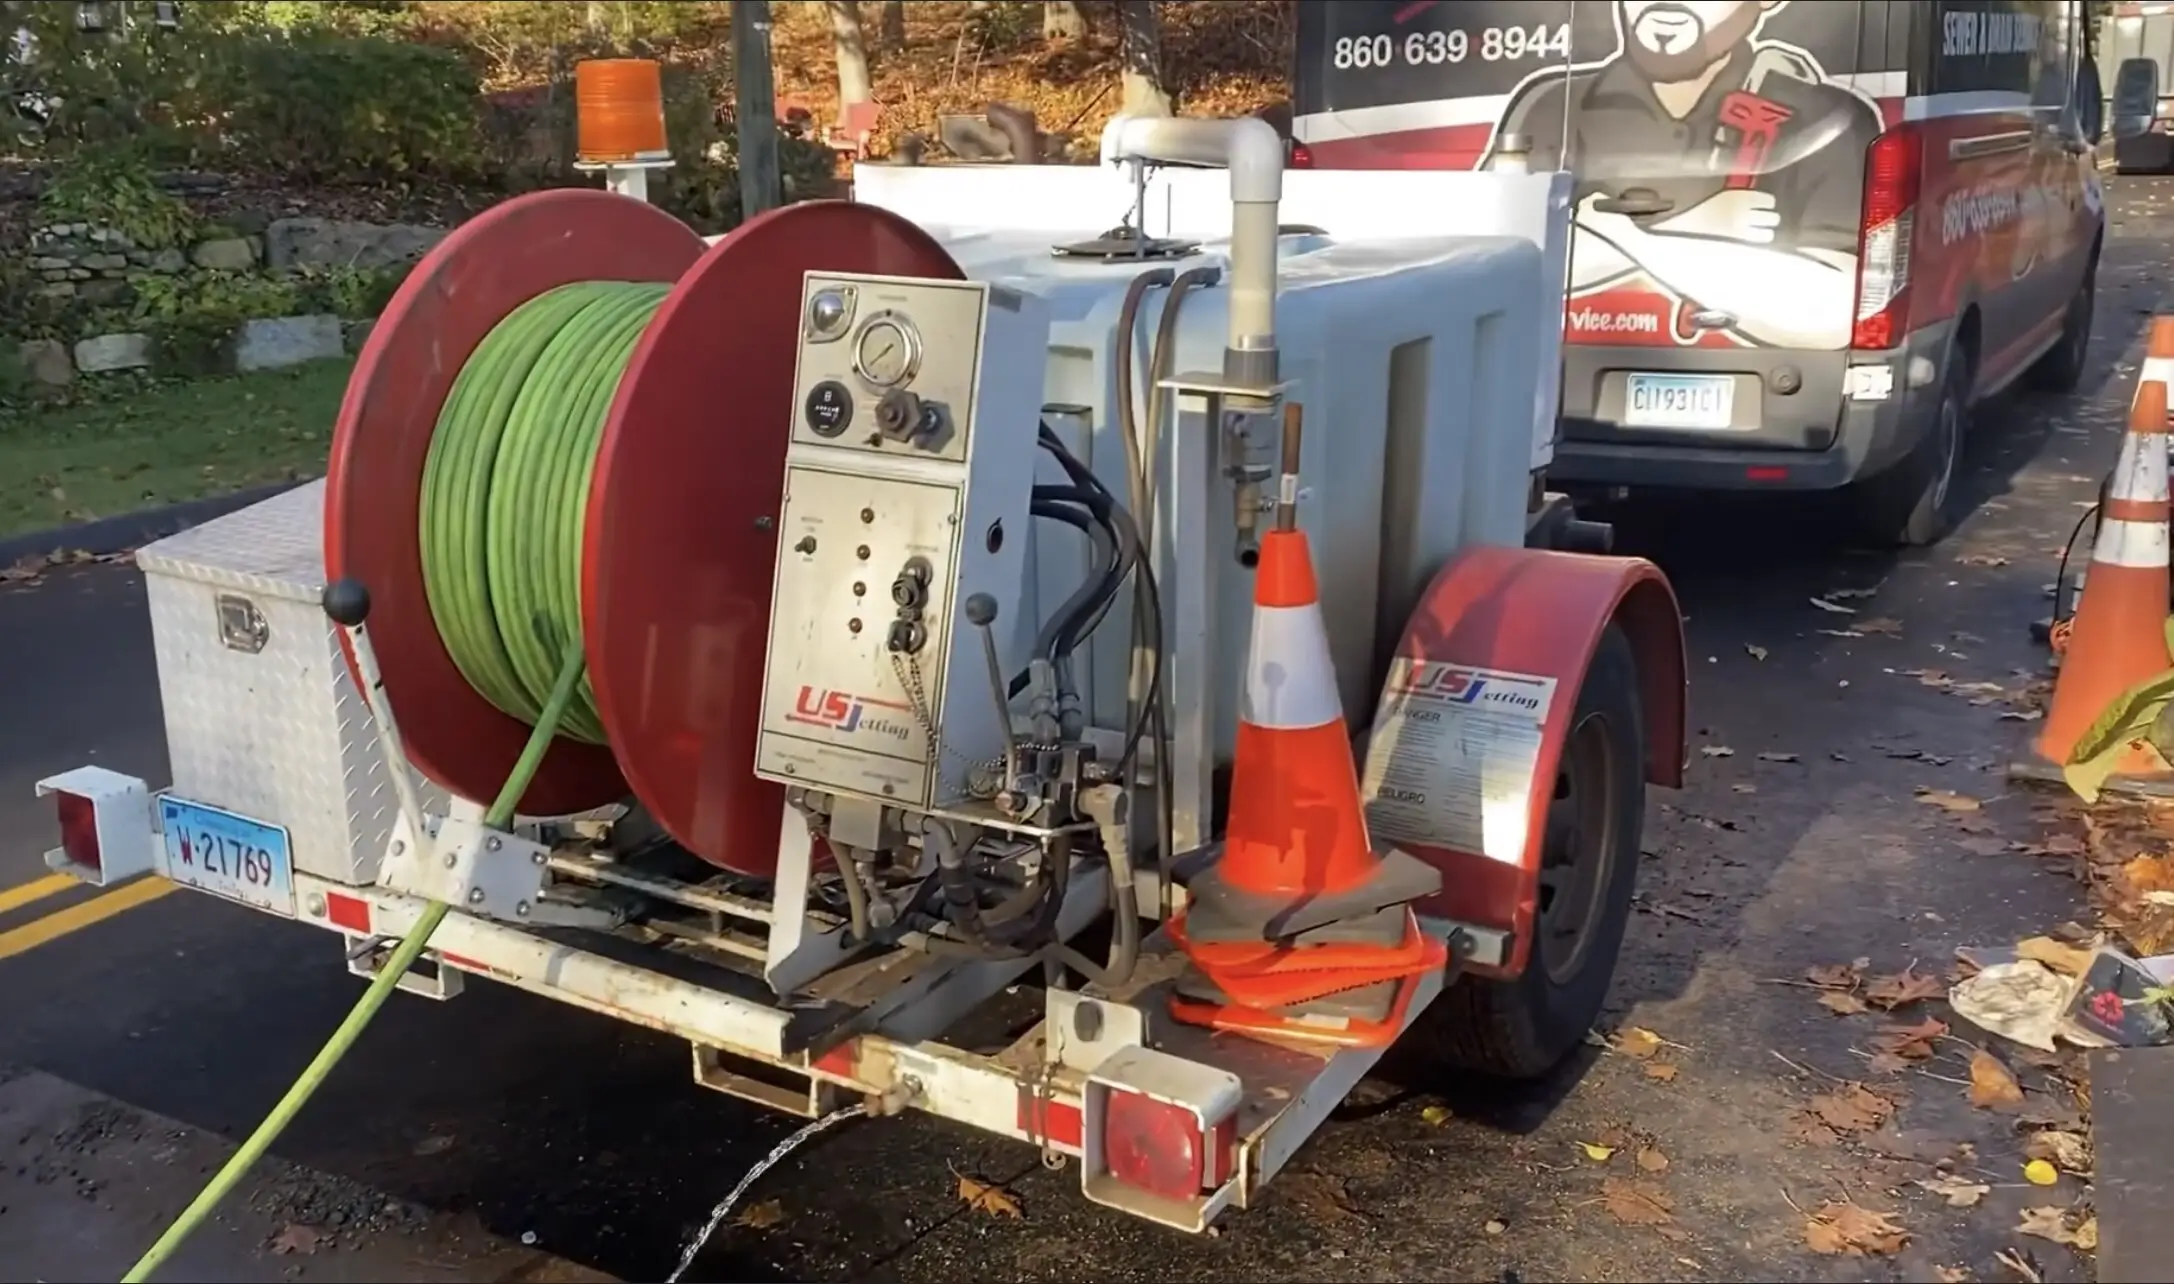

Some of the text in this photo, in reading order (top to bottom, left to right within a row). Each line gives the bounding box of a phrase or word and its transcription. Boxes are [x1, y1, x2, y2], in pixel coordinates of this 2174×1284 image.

[1333, 23, 1570, 69] 860 639 8944
